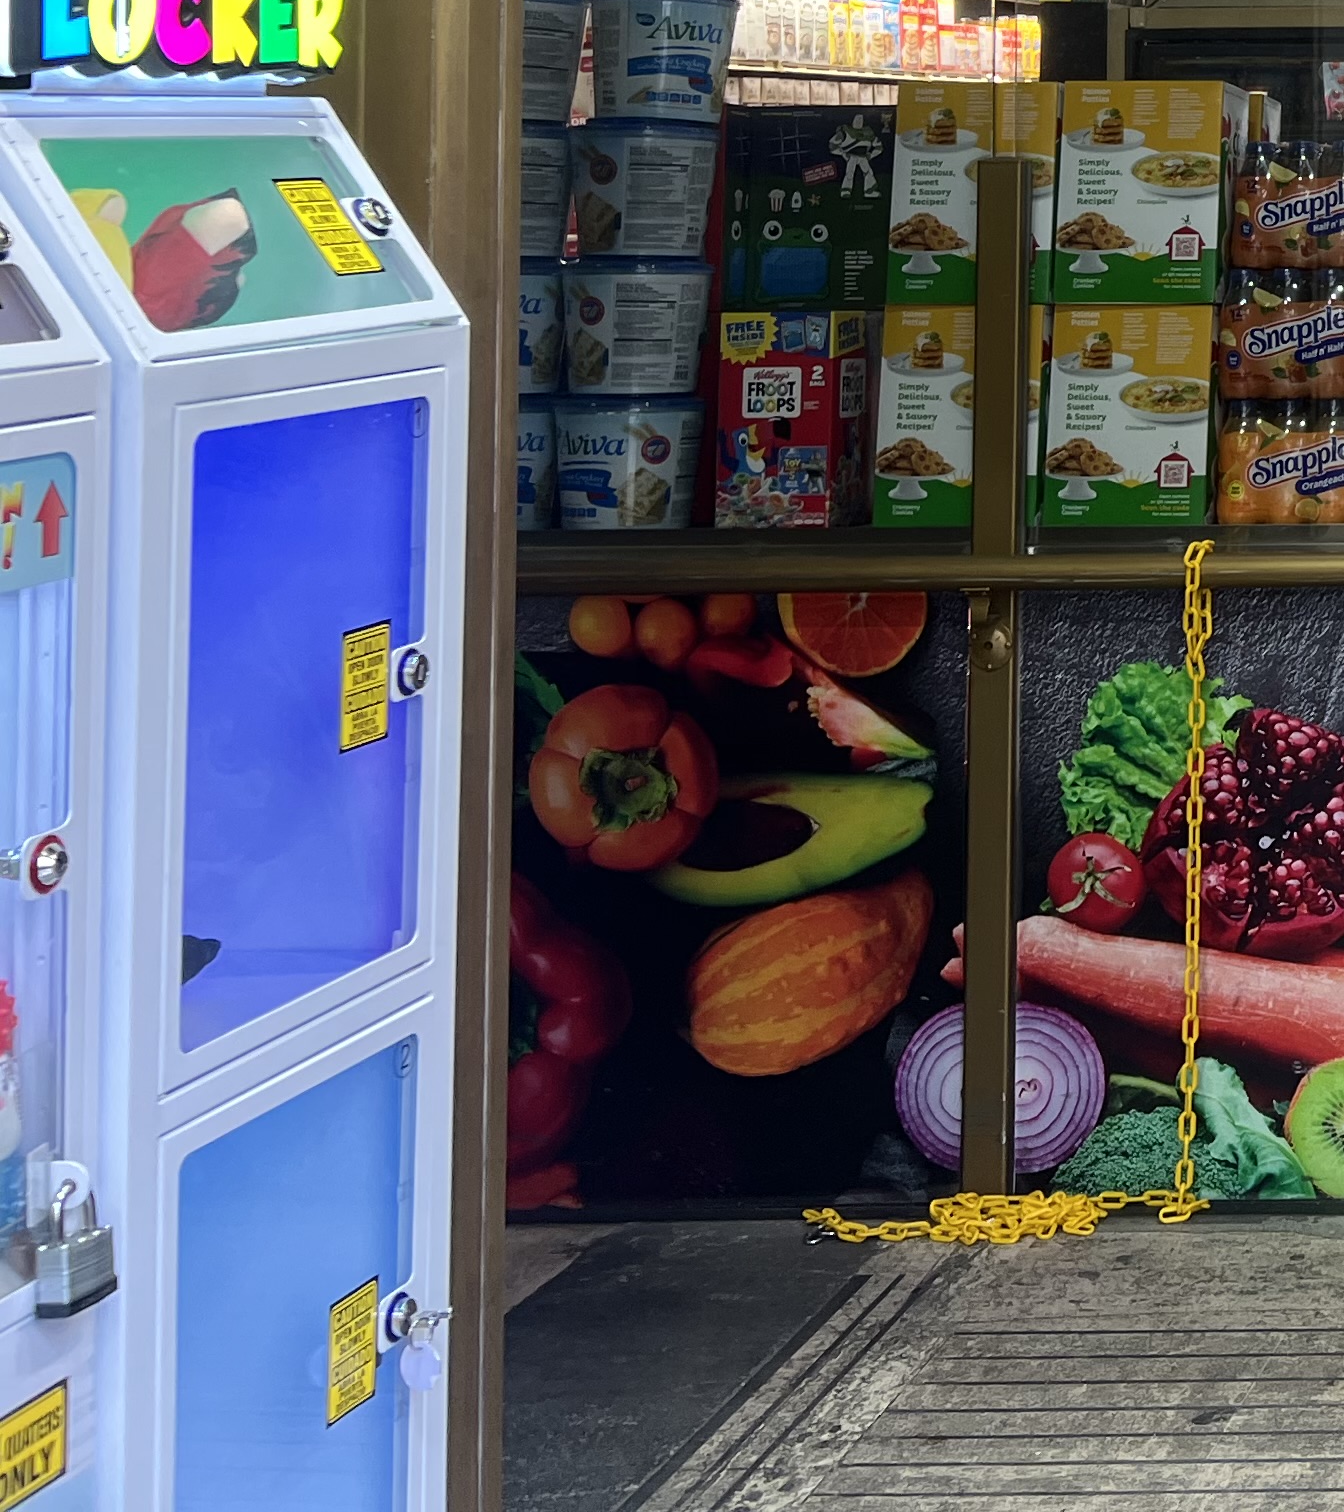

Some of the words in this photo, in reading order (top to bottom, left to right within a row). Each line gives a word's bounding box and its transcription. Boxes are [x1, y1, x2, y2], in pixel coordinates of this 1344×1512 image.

[645, 15, 724, 45] Aviva
[911, 159, 944, 168] Simply
[1078, 159, 1110, 168] Simply
[919, 188, 951, 197] Savory
[1086, 188, 1119, 197] Savory
[1312, 219, 1330, 232] Half
[726, 320, 766, 334] FREE
[726, 331, 766, 343] INSIDE
[1302, 346, 1320, 361] Half
[1330, 341, 1344, 354] Half
[754, 368, 791, 382] Kellogg's
[811, 365, 824, 380] 2
[747, 381, 796, 397] FROOT
[898, 383, 930, 392] Simply
[1067, 383, 1100, 393] Simply
[747, 397, 796, 413] LOOPS
[897, 402, 926, 410] Sweet
[1066, 403, 1095, 411] Sweet
[905, 412, 938, 422] Savory
[1074, 412, 1107, 423] Savory
[559, 429, 626, 456] Aviva
